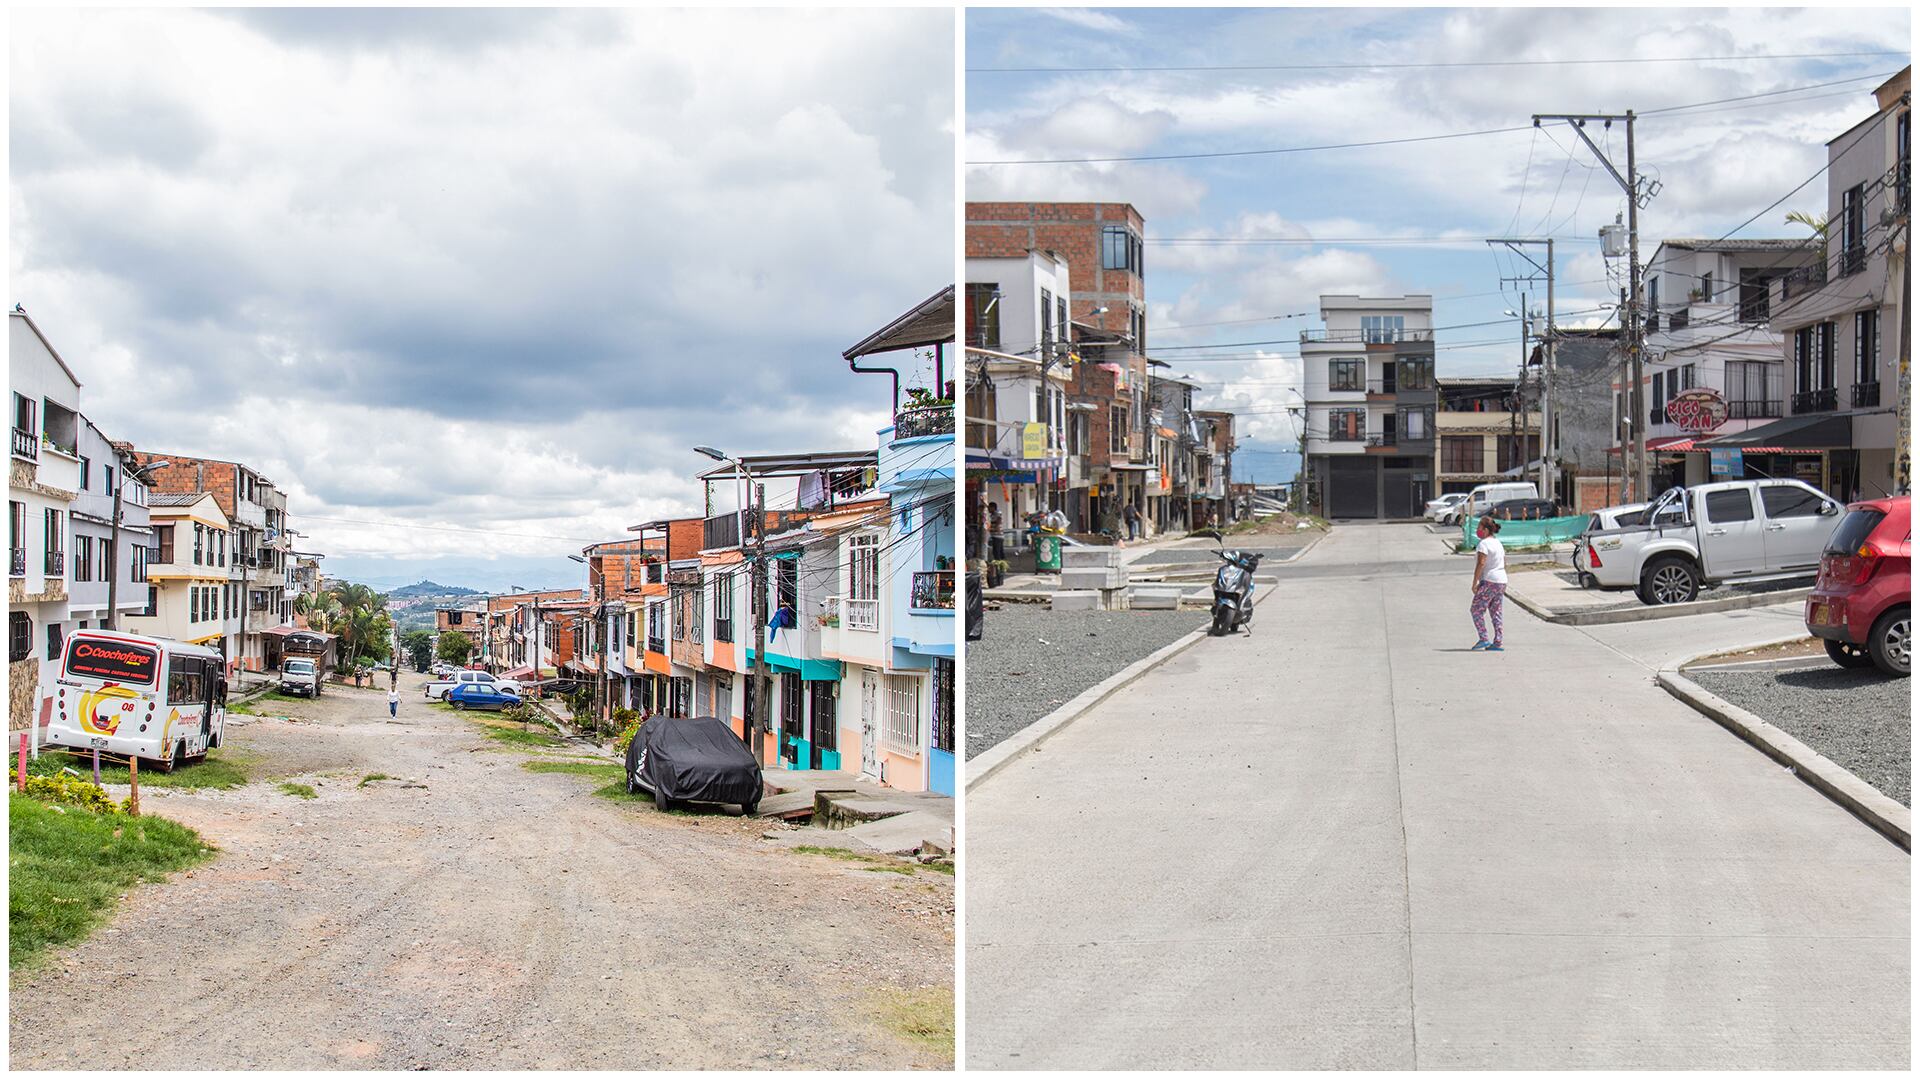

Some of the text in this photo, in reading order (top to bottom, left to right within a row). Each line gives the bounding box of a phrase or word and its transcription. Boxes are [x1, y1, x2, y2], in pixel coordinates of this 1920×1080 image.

[1667, 400, 1701, 416] RICO
[1679, 415, 1712, 431] PAN
[92, 647, 151, 664] Coochoferes
[121, 703, 135, 712] 08
